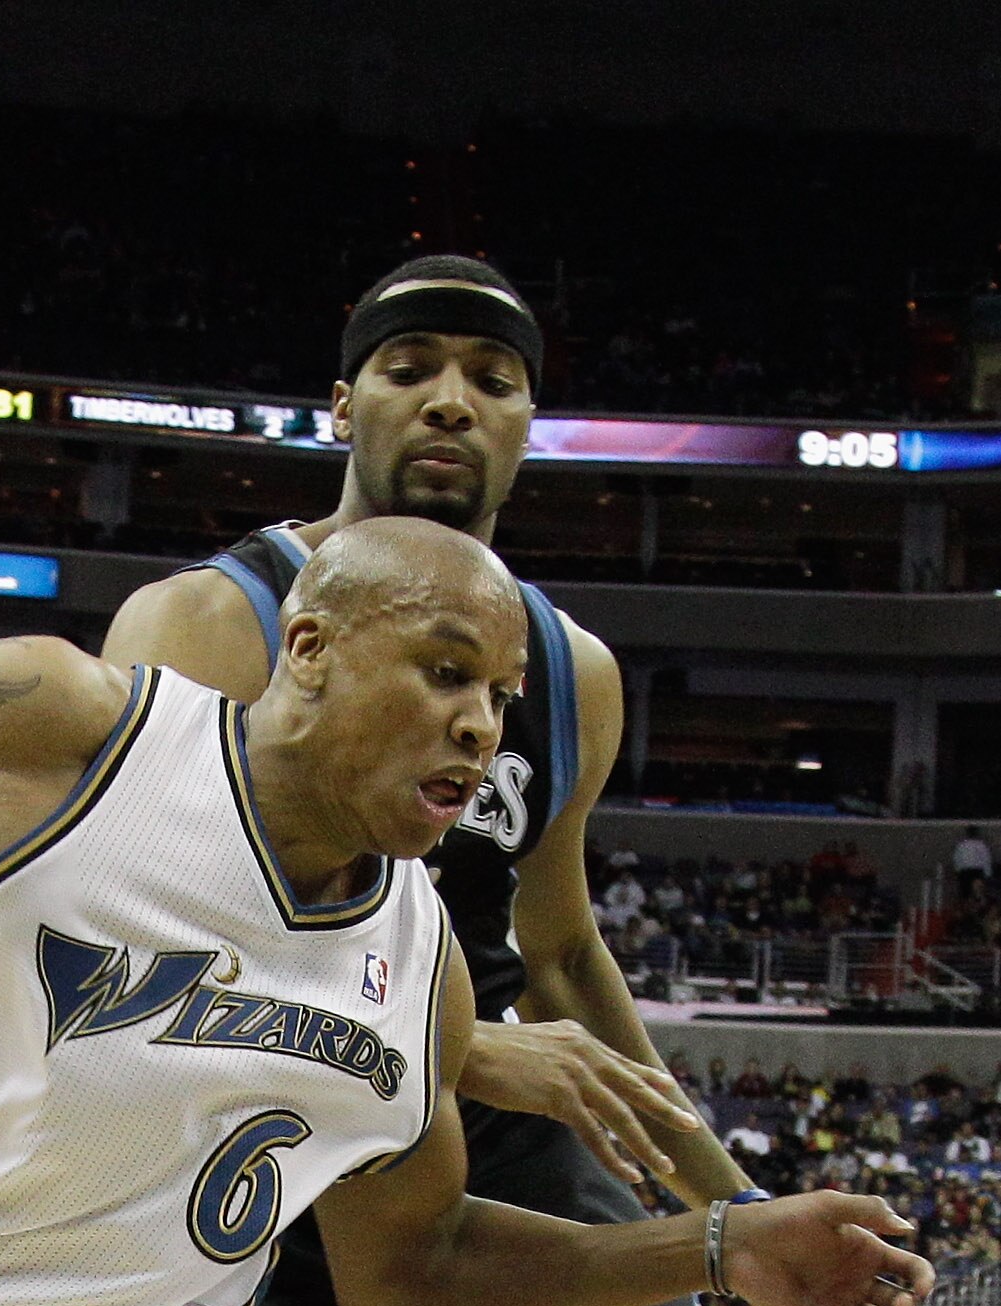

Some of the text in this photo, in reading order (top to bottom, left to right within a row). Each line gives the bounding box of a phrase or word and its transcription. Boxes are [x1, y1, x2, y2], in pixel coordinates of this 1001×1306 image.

[69, 395, 236, 432] TIMBERWOLVES
[262, 416, 284, 439] 2
[797, 430, 898, 468] 9:05
[36, 923, 409, 1101] WIZARDS
[186, 1109, 313, 1265] 6
